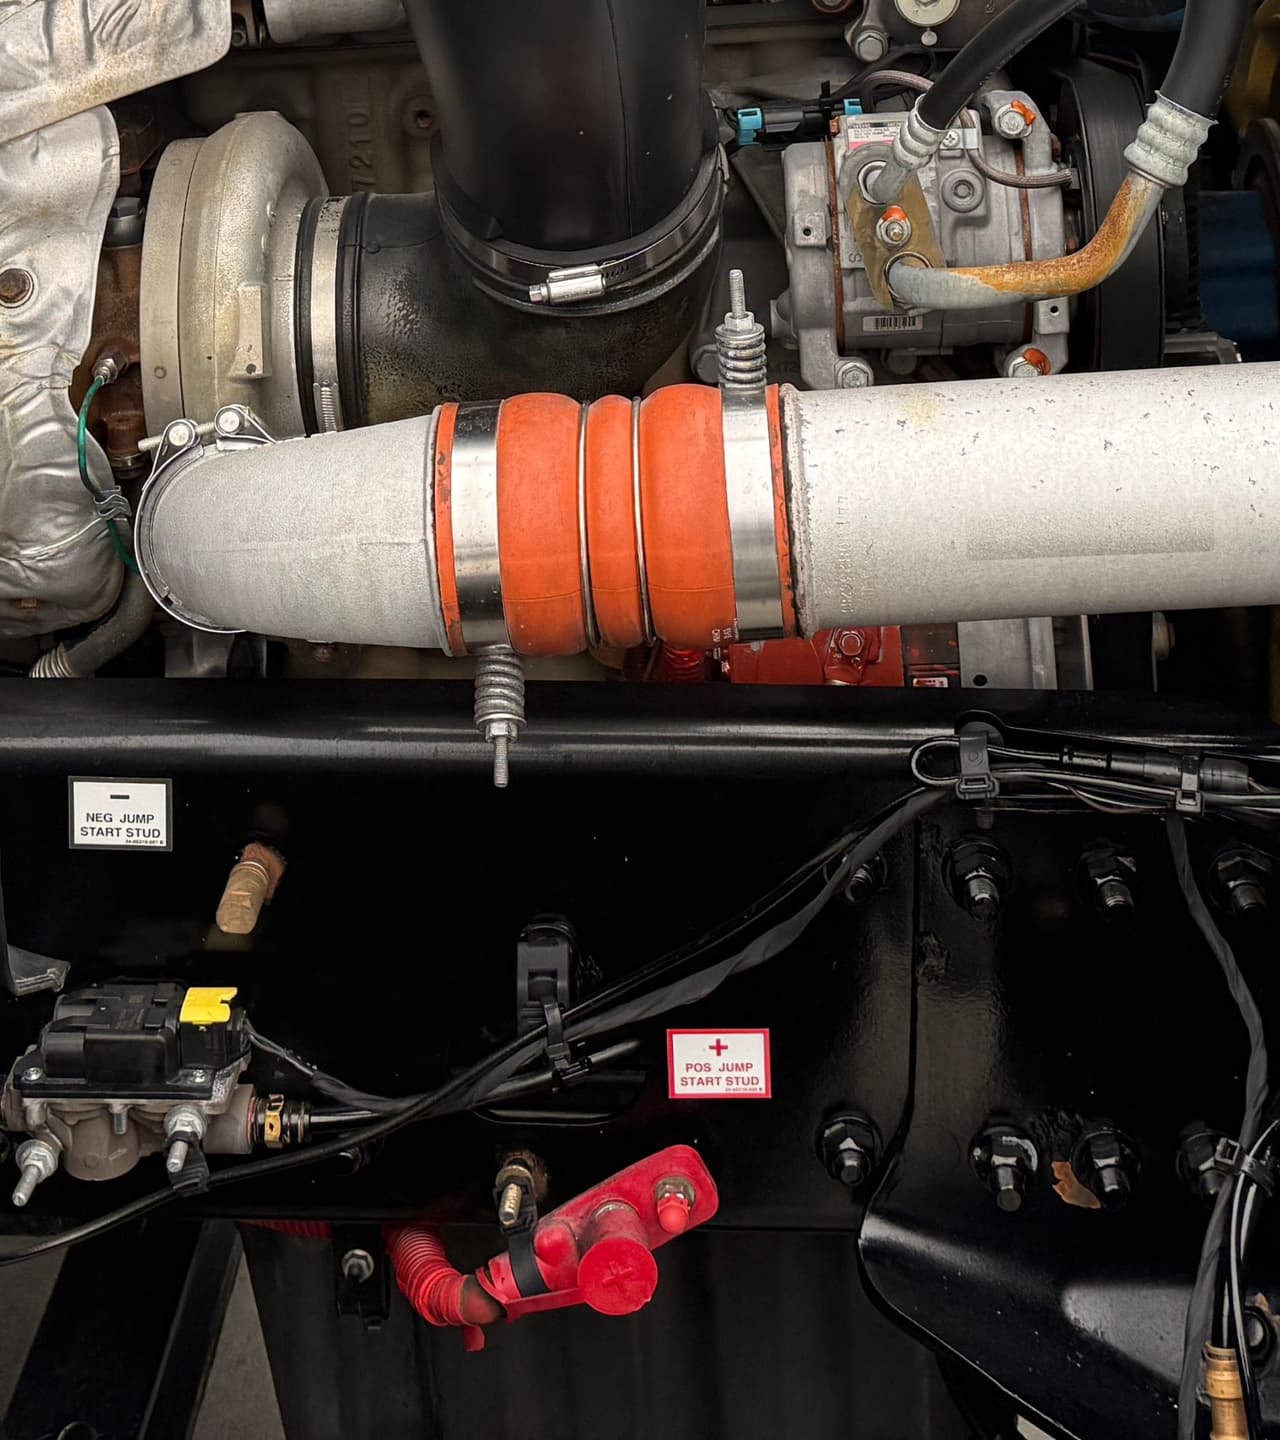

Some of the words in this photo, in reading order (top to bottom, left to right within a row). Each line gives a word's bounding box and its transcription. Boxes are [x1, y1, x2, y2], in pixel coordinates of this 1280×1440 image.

[86, 812, 113, 823] NEG
[119, 813, 155, 824] JUMP
[80, 826, 122, 837] START
[126, 827, 161, 839] STUD
[685, 1062, 712, 1073] POS
[718, 1062, 754, 1073] JUMP
[680, 1076, 722, 1087] START
[725, 1076, 760, 1087] STUD
